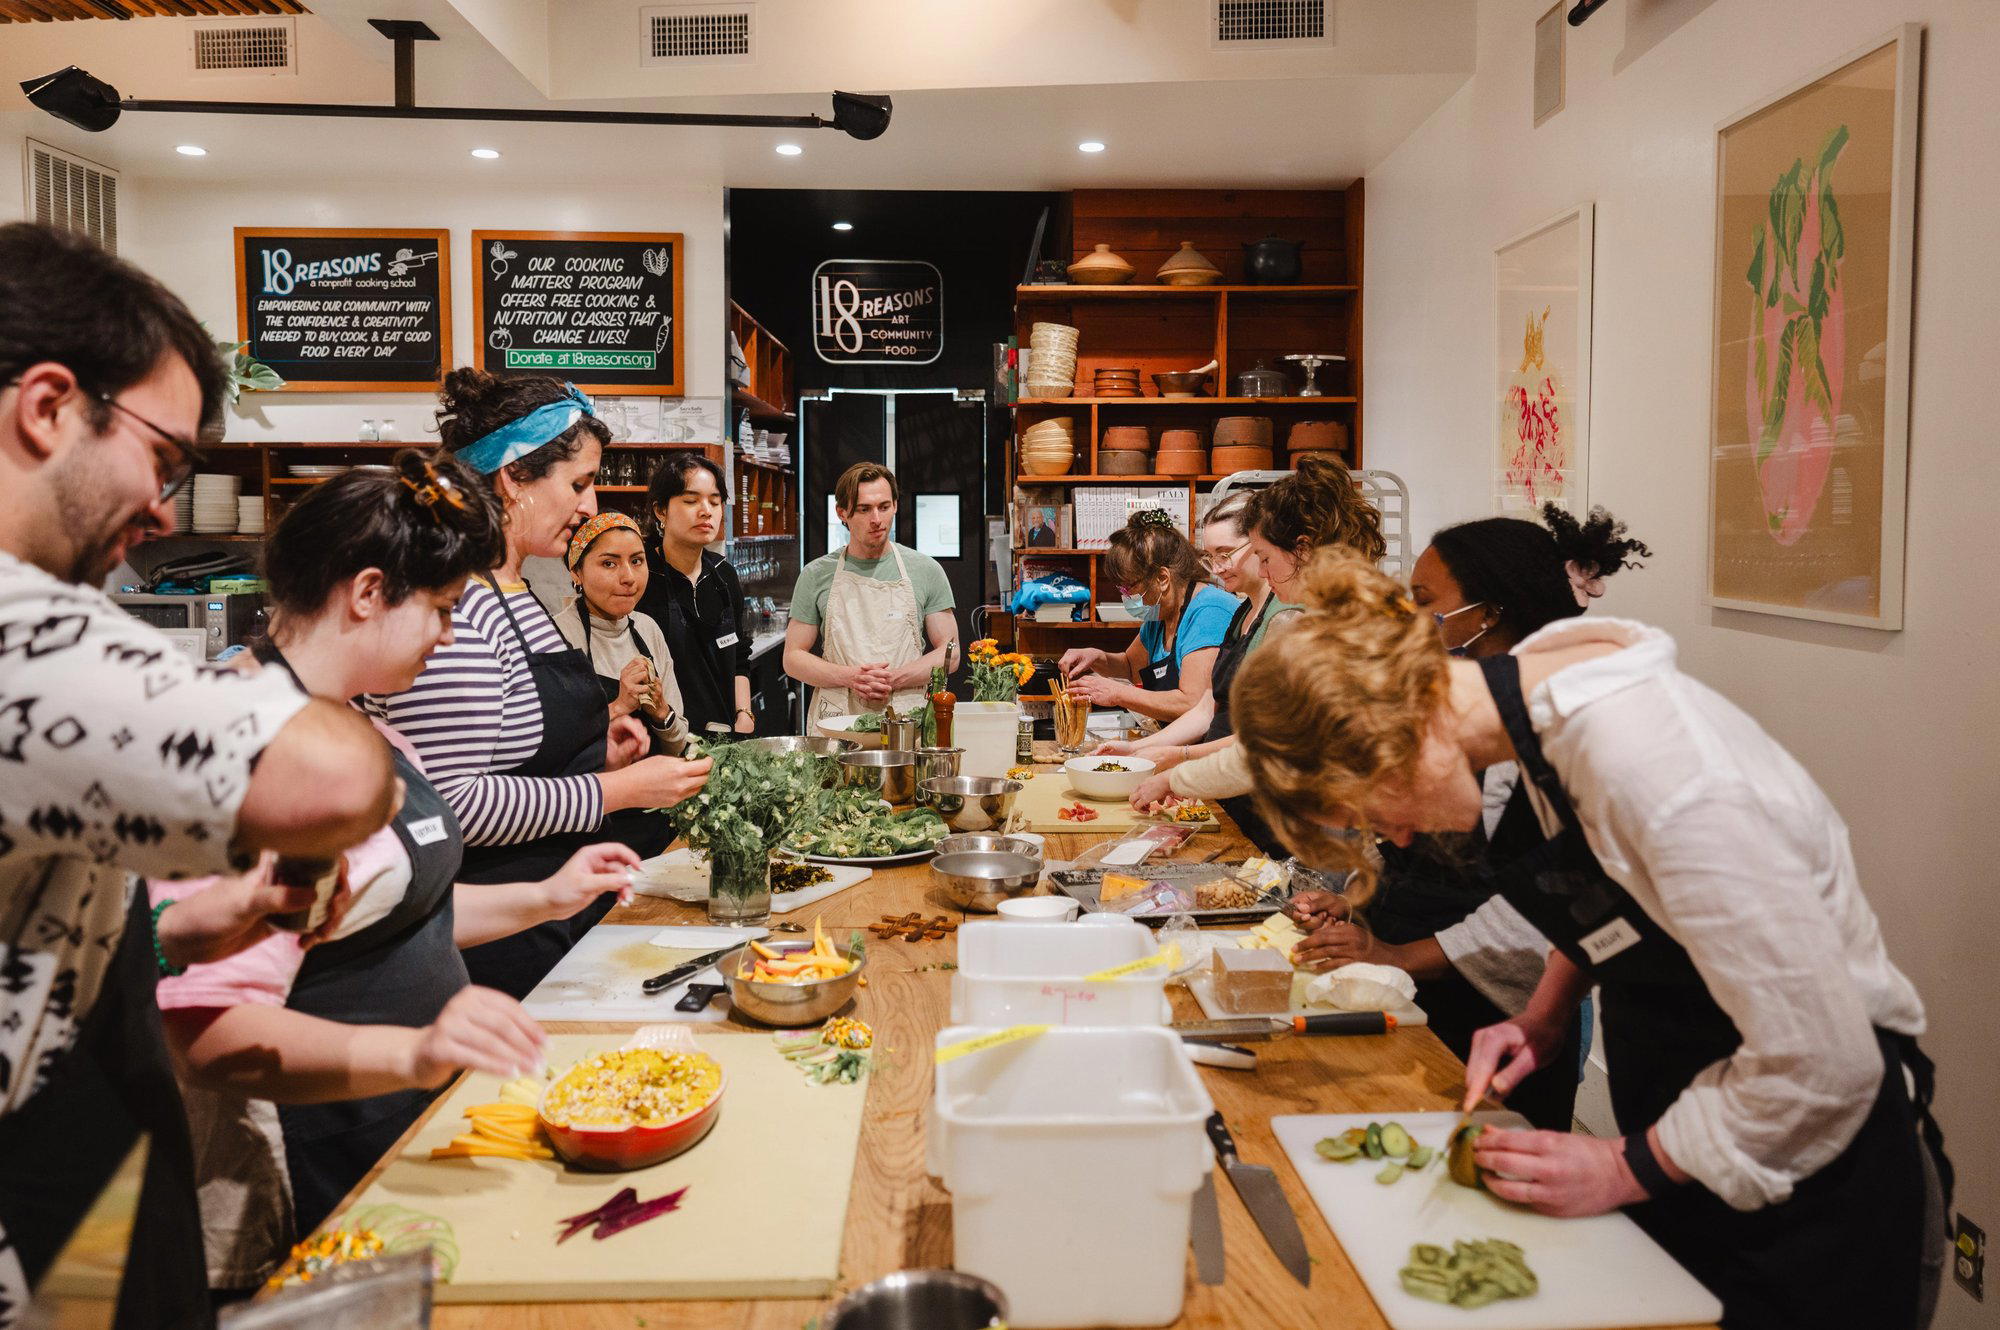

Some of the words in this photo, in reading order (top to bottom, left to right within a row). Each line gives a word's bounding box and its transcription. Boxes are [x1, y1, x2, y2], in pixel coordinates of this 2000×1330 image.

[262, 248, 295, 295] 18
[295, 252, 382, 283] REASONS
[528, 257, 556, 272] OUR
[564, 257, 624, 272] COOKING
[318, 277, 353, 290] nonprofit
[356, 277, 389, 290] cooking
[390, 277, 416, 288] school
[511, 275, 574, 290] MATTERS
[579, 275, 644, 290] PROGRAM
[258, 300, 320, 312] EMPOWERING
[322, 300, 342, 312] OUR
[343, 300, 404, 312] COMMUNITY
[406, 301, 430, 312] WITH
[500, 293, 547, 308] OFFERS
[550, 293, 584, 308] FREE
[585, 294, 640, 308] COOKING
[645, 294, 656, 308] &
[265, 315, 284, 327] THE
[288, 316, 350, 327] CONFIDENCE
[352, 316, 360, 327] &
[363, 316, 423, 328] CREATIVITY
[494, 311, 568, 326] NUTRITION
[571, 311, 626, 327] CLASSES
[628, 312, 660, 328] THAT
[818, 276, 862, 354] 18
[862, 287, 934, 319] REASONS
[891, 315, 910, 325] ART
[260, 330, 301, 342] NEEDED
[304, 330, 317, 342] TO
[318, 330, 340, 343] BUY,
[340, 331, 368, 343] COOK,
[371, 330, 380, 342] &
[382, 331, 402, 342] EAT
[404, 331, 432, 342] GOOD
[533, 329, 586, 344] CHANGE
[588, 329, 630, 345] LIVES!
[870, 330, 932, 340] COMMUNITY
[300, 346, 330, 357] FOOD
[334, 346, 370, 358] EVERY
[374, 346, 397, 358] DAY
[885, 346, 917, 356] FOOD
[510, 352, 554, 364] Donate
[558, 352, 570, 365] at
[572, 352, 651, 368] 18reasons.org
